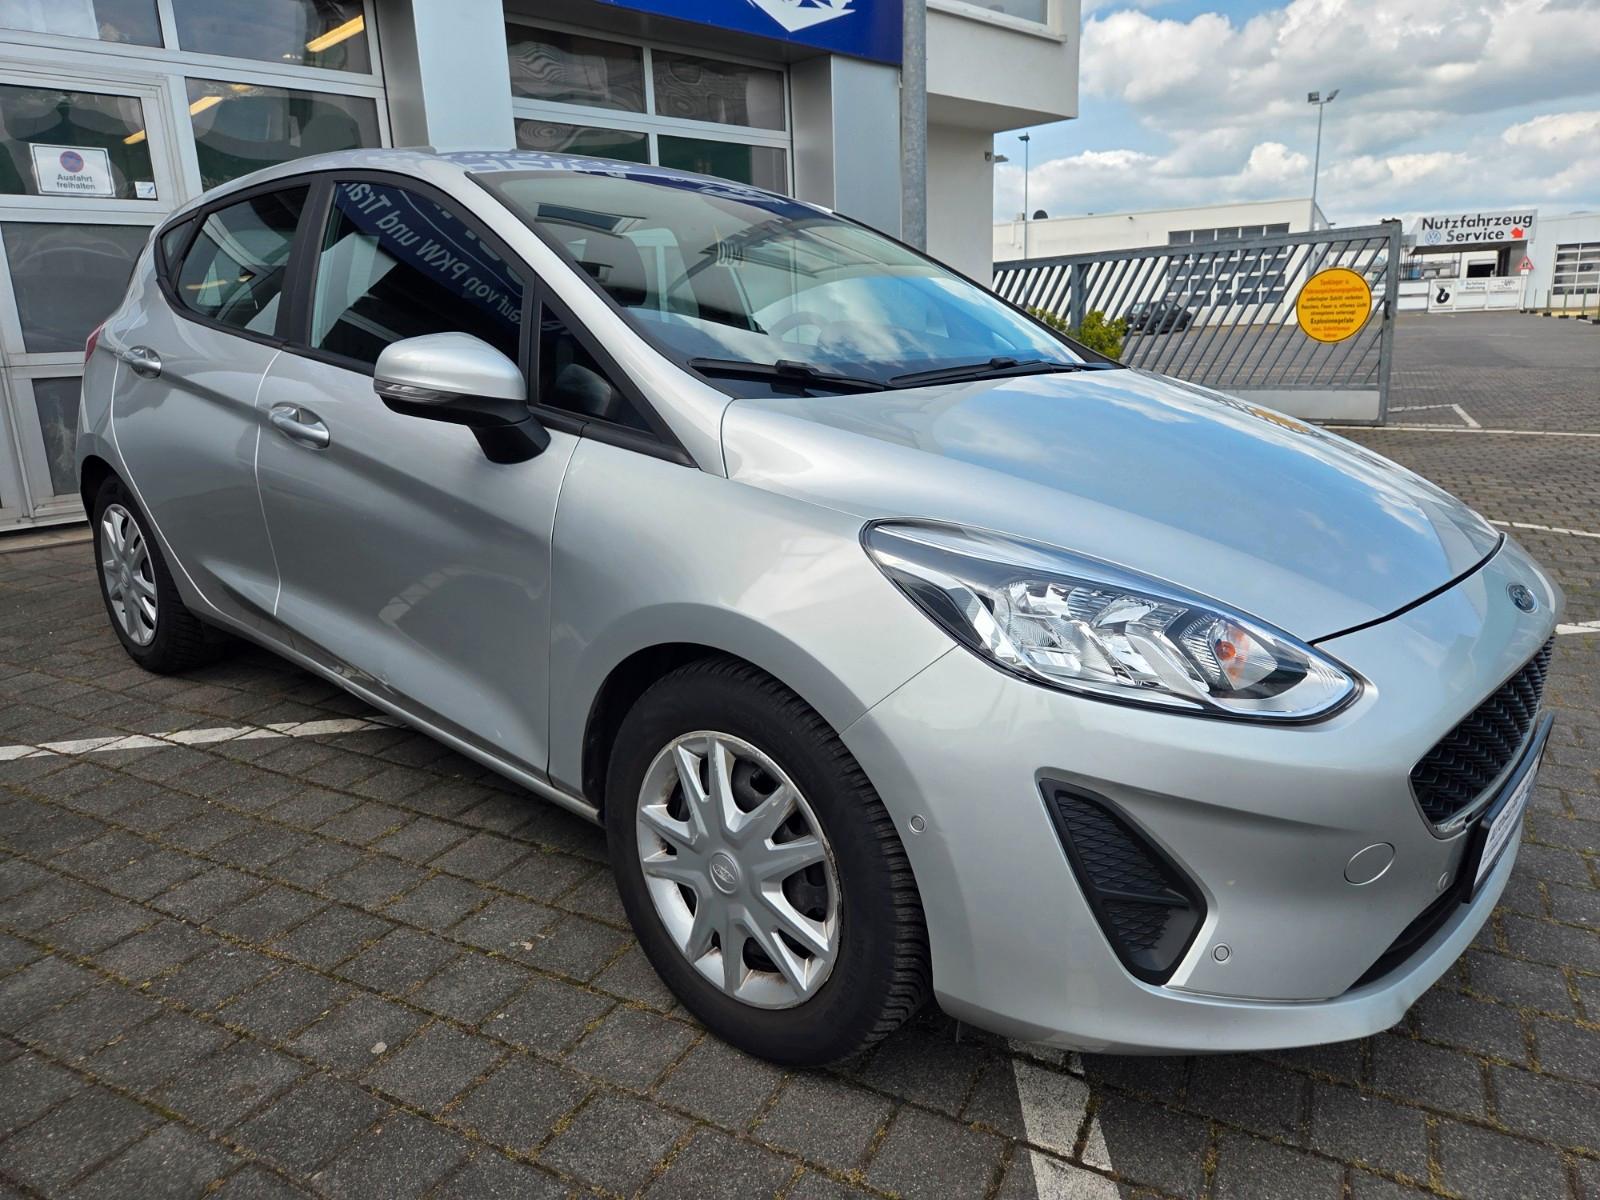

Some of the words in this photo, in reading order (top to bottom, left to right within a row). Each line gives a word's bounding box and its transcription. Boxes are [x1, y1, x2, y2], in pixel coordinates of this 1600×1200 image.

[57, 174, 93, 182] Ausfahrt
[56, 181, 96, 190] freihalten
[1421, 214, 1533, 230] Nutzfahrzeug
[1446, 228, 1505, 242] Service
